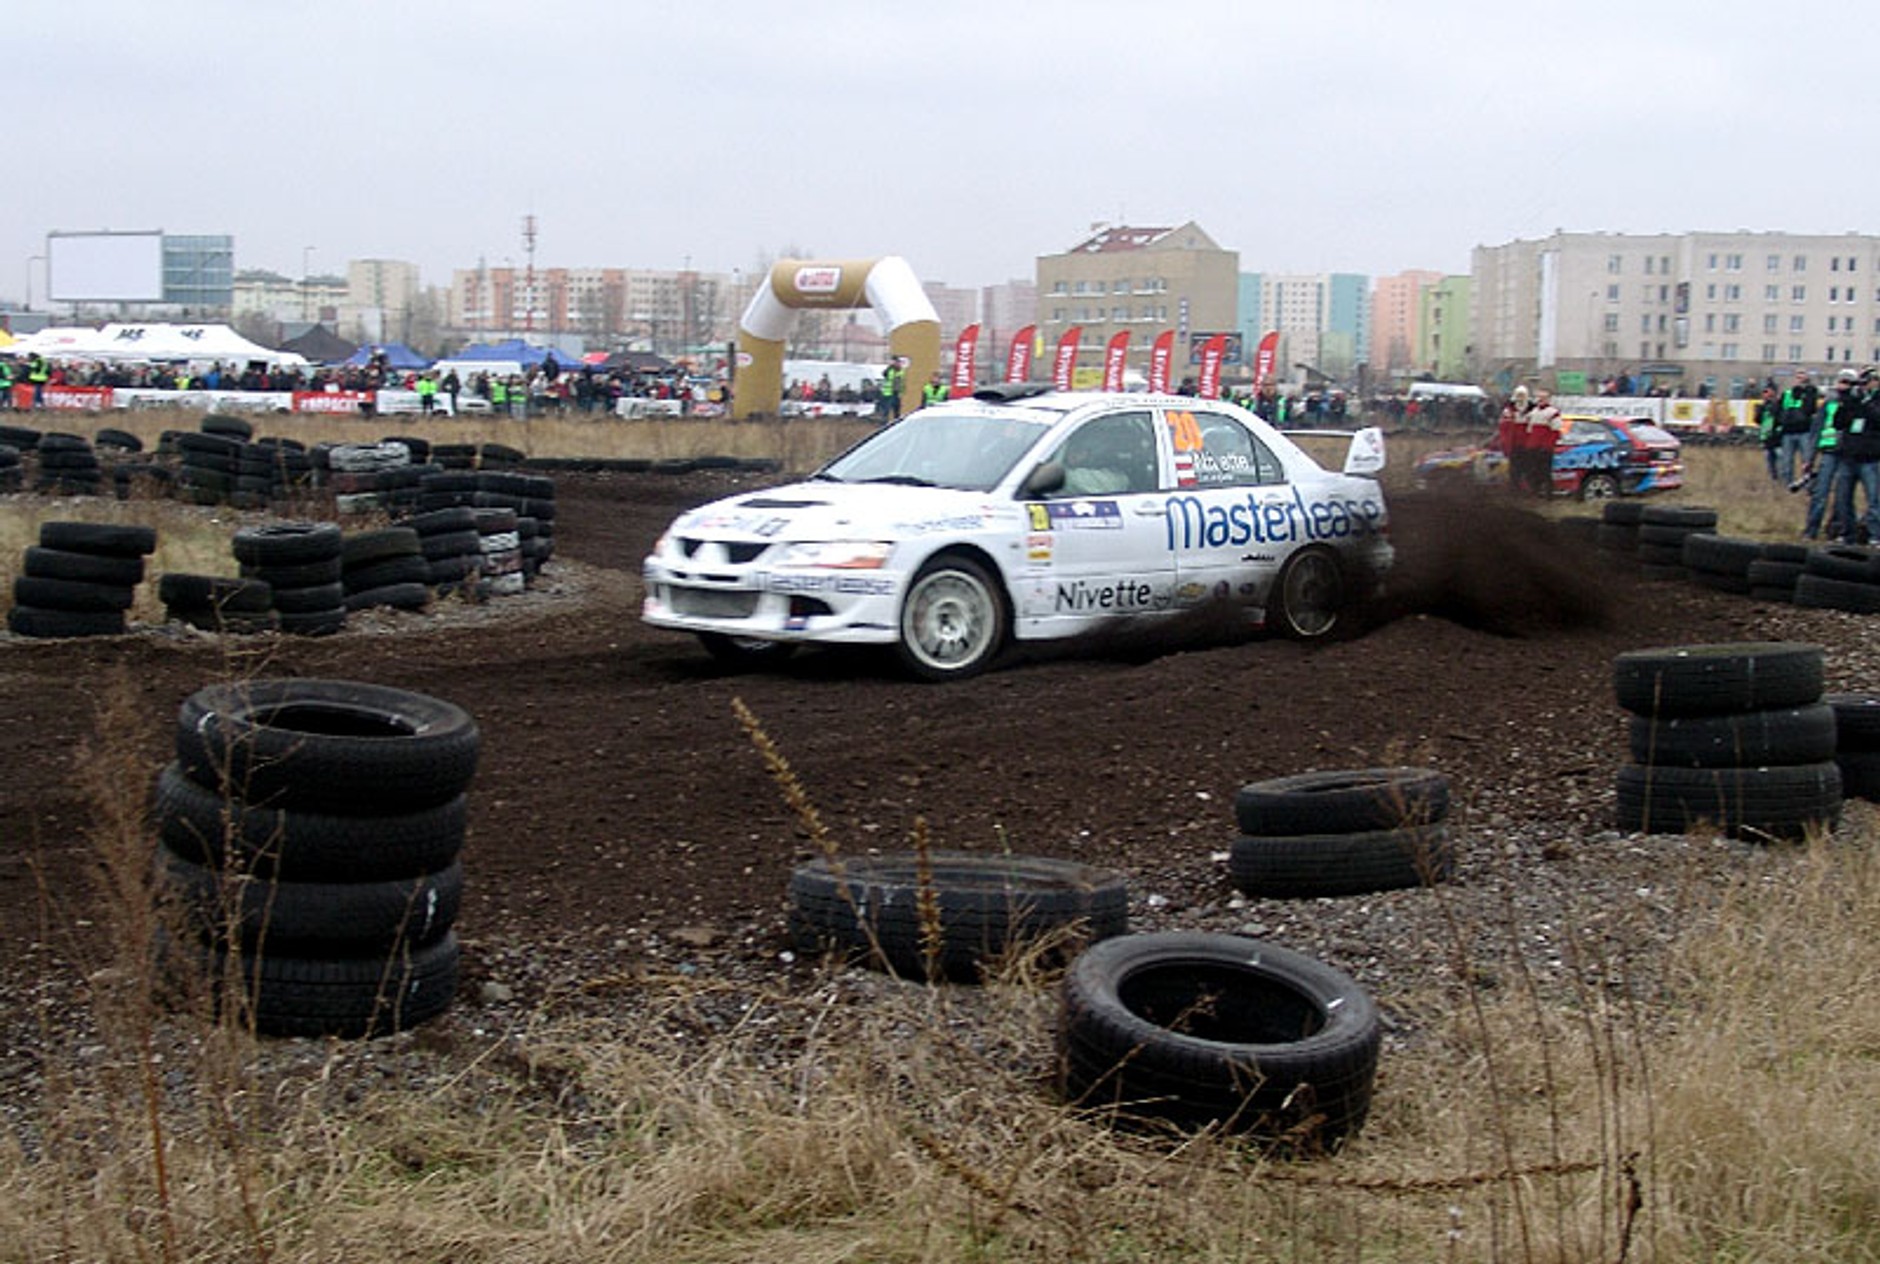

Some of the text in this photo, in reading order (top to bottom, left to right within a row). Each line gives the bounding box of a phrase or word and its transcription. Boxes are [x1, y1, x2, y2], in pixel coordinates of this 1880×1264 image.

[1166, 411, 1204, 452] 20
[1166, 486, 1379, 552] Masterlease
[1055, 580, 1151, 612] Nivette
